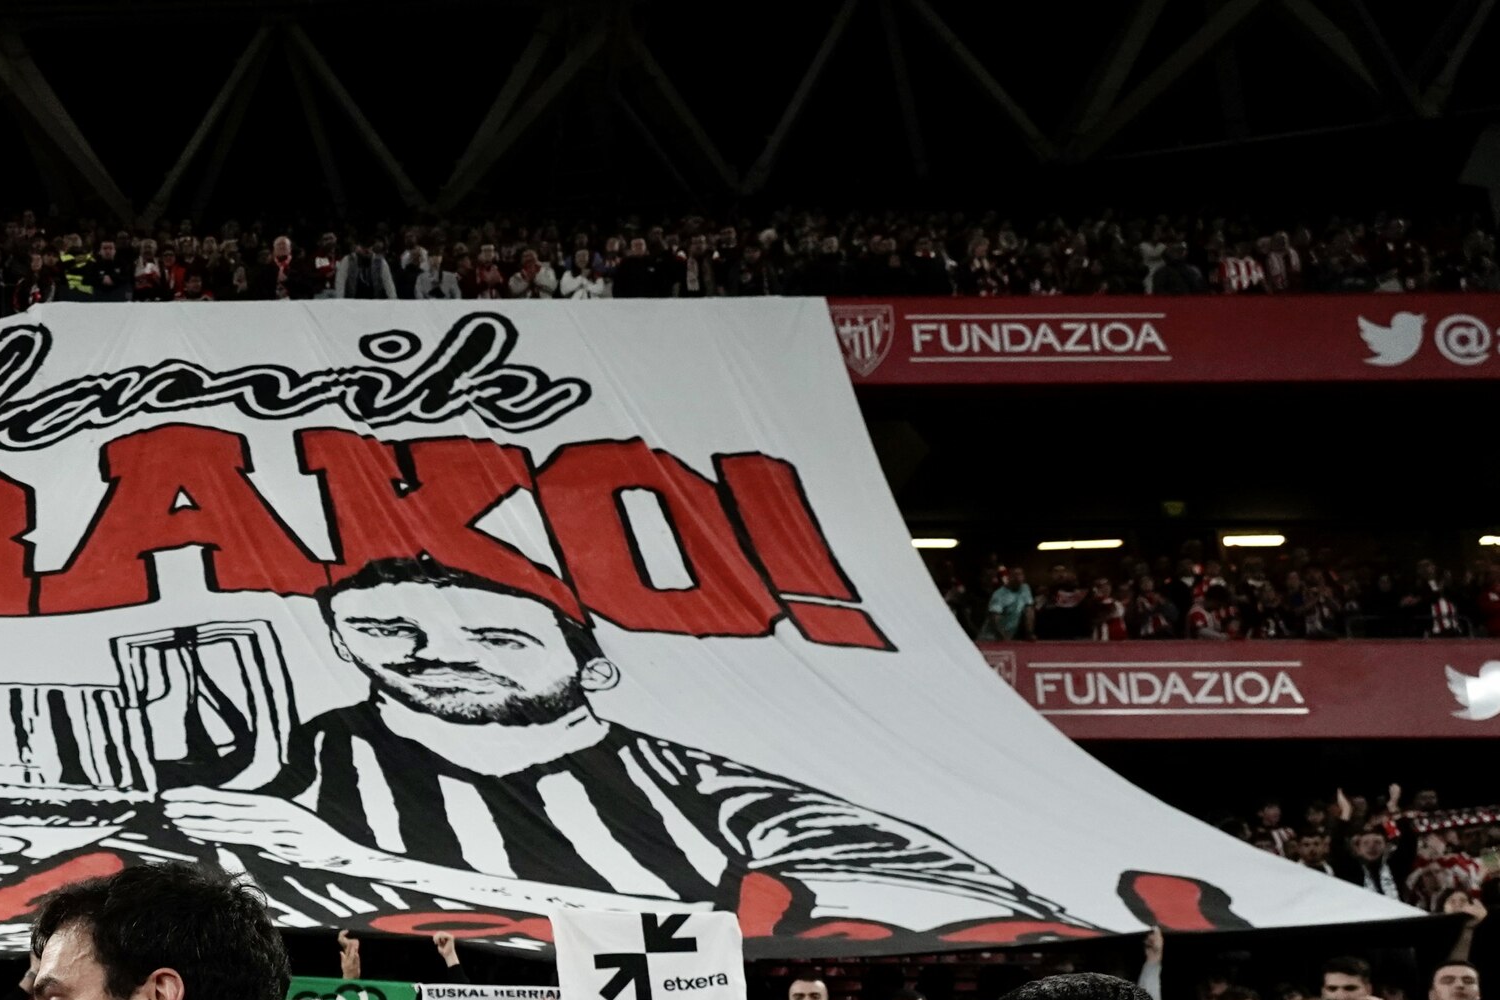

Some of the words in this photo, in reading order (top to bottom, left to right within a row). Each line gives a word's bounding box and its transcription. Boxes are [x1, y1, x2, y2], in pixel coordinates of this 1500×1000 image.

[911, 321, 1168, 354] FUNDAZIOA
[1034, 671, 1305, 705] FUNDAZIOA
[427, 988, 488, 999] EUSKAL
[494, 989, 562, 1000] HERRIA
[663, 972, 729, 991] etxera
